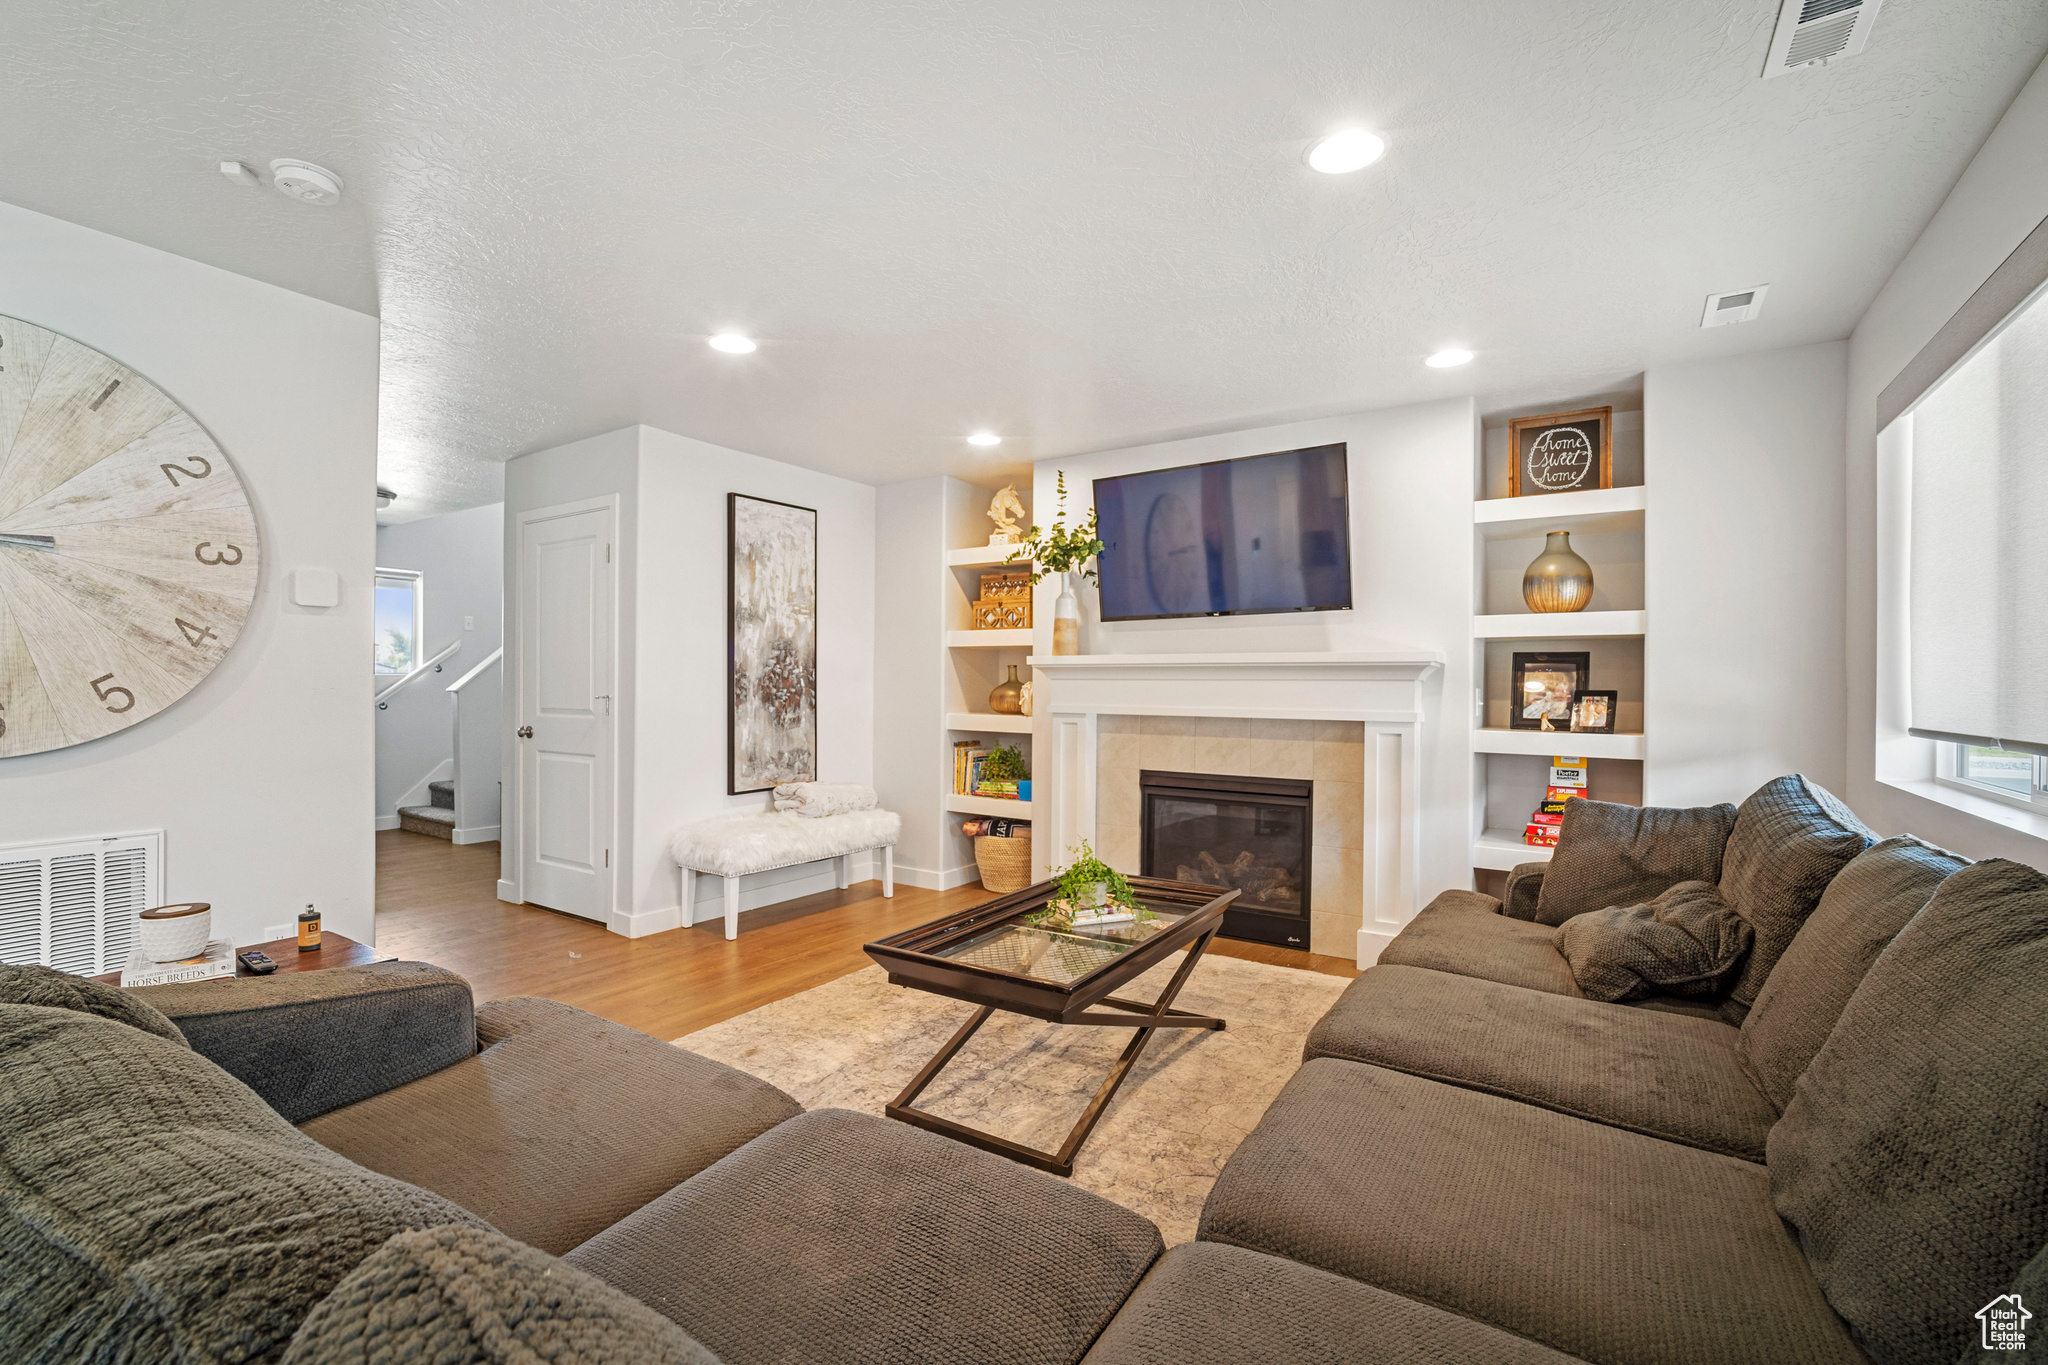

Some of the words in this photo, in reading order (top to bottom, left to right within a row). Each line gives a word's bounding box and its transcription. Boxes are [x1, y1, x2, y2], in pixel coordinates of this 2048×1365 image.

[1541, 432, 1583, 452] home
[1541, 449, 1582, 467] sweet
[160, 455, 212, 487] 2
[1539, 466, 1577, 483] home
[195, 541, 243, 566] 3
[174, 617, 218, 649] 4
[90, 672, 135, 714] 5
[128, 975, 165, 987] HORSE
[167, 969, 206, 983] BREEDS
